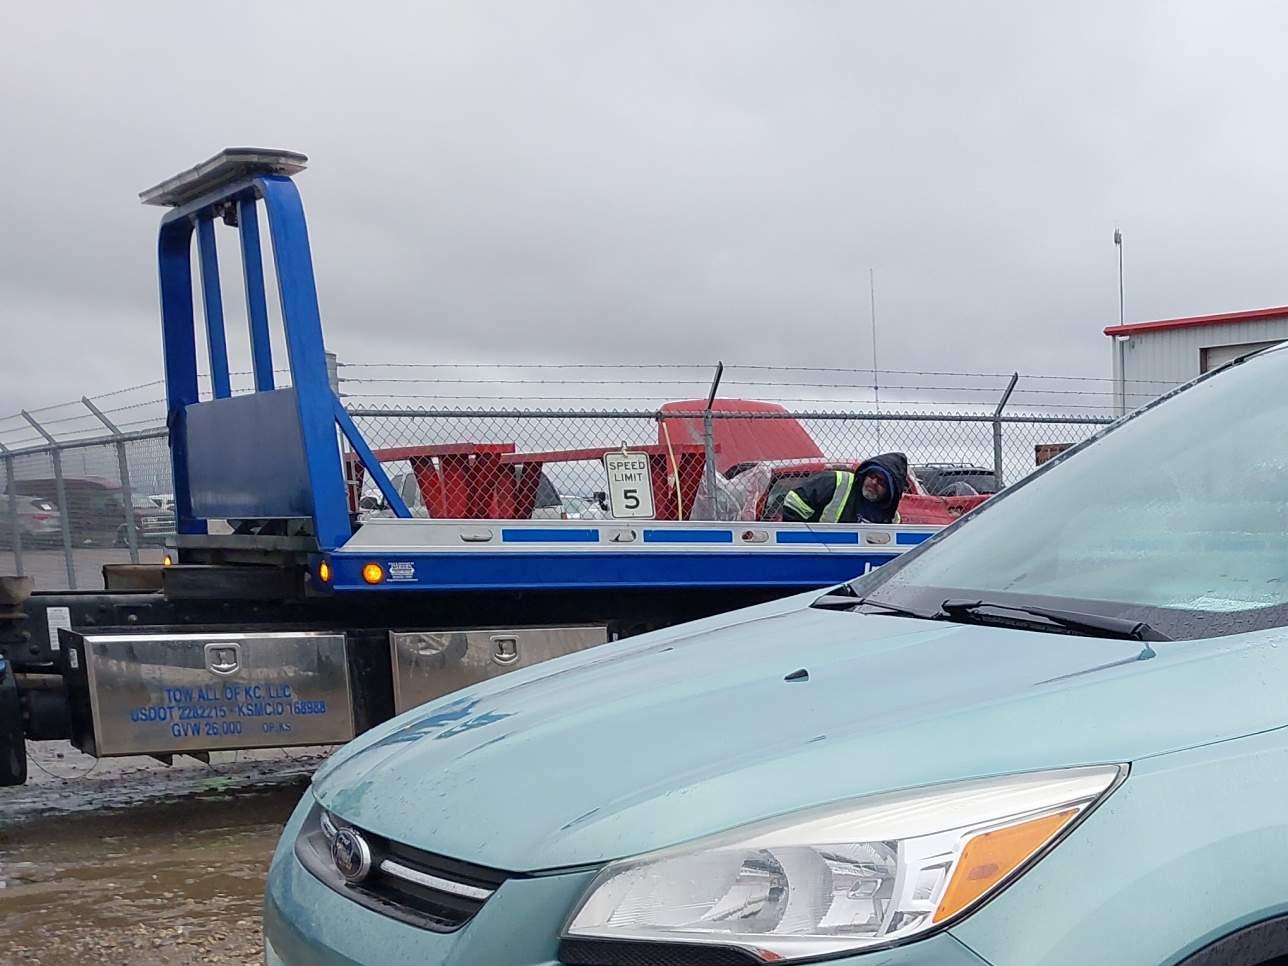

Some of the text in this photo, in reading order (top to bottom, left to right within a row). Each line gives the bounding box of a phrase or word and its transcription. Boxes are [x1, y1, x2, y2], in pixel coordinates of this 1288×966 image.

[609, 461, 646, 470] SPEED
[614, 473, 643, 481] LIMIT
[623, 489, 640, 510] 5
[164, 687, 193, 703] TOW
[198, 687, 220, 701] ALL
[224, 687, 240, 700] OF
[268, 684, 292, 699] LLC
[130, 706, 175, 722] USDOT
[171, 722, 200, 737] GVW
